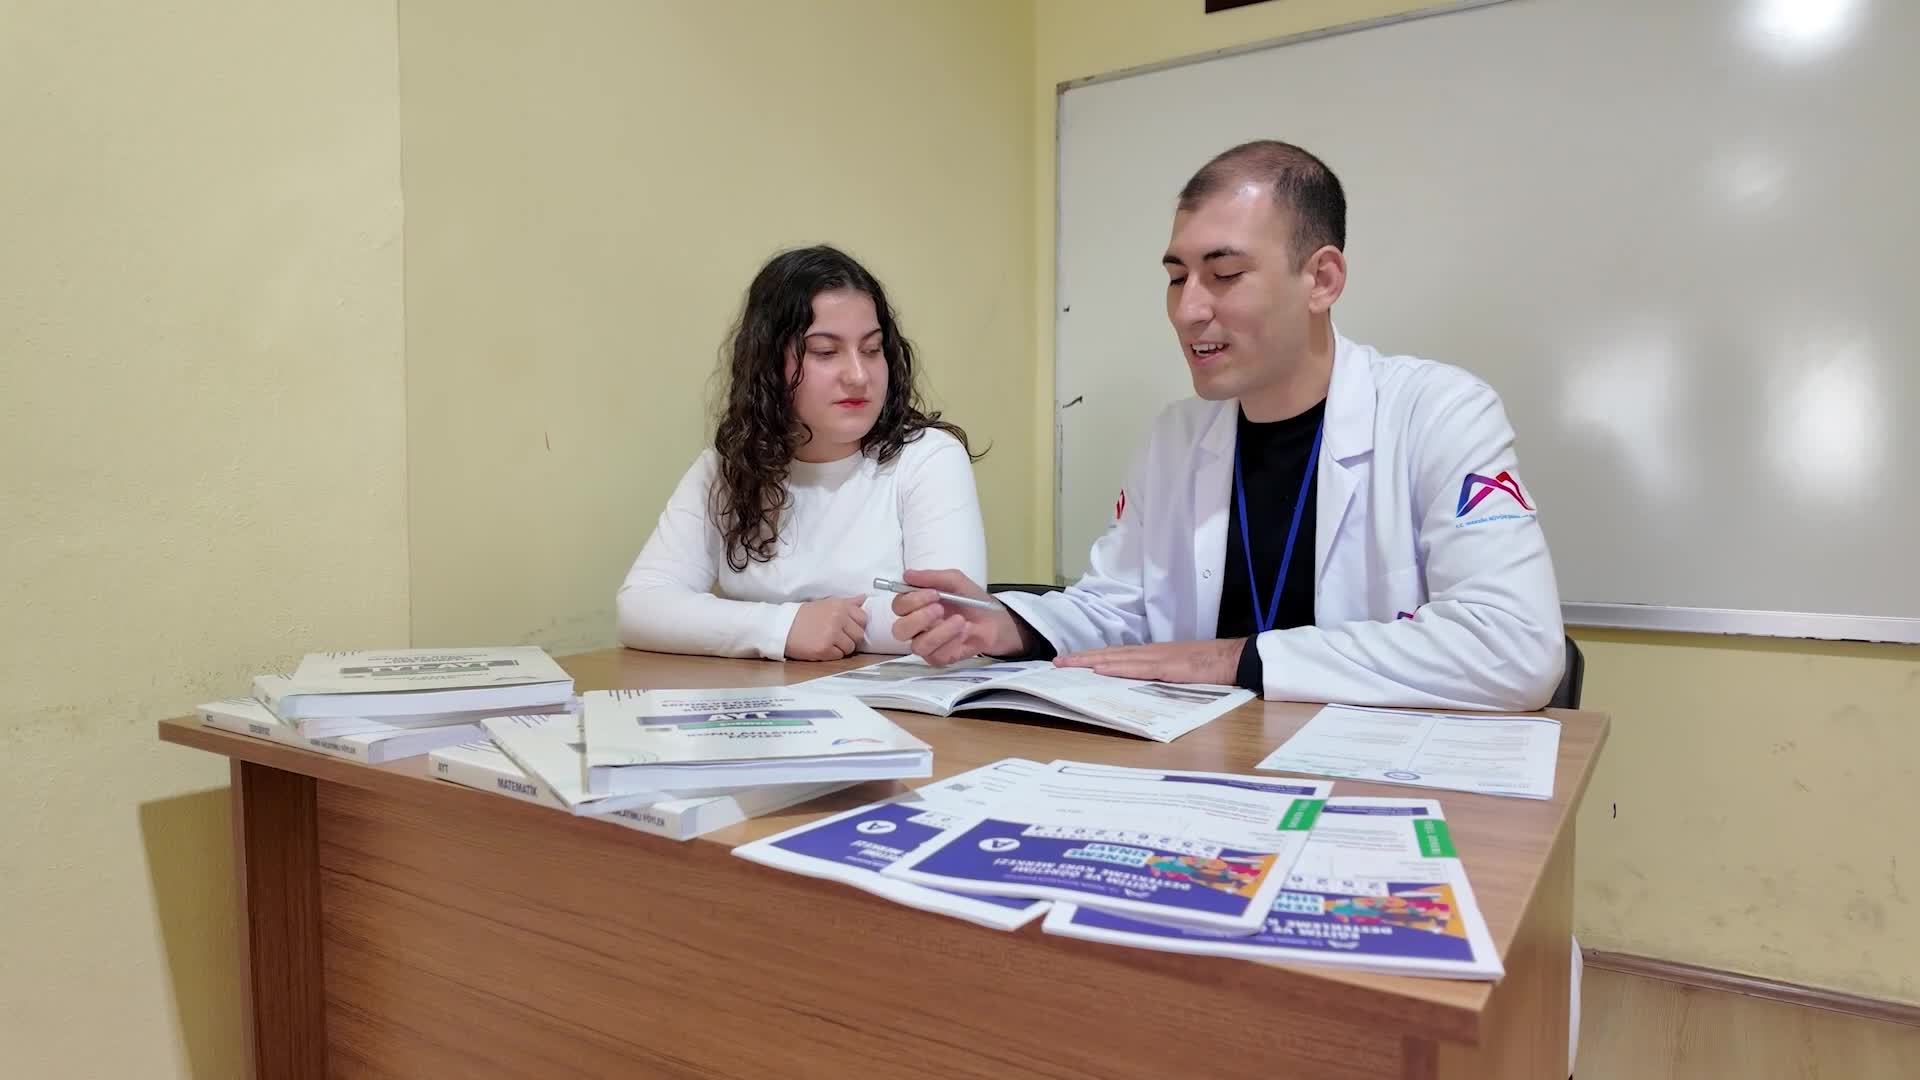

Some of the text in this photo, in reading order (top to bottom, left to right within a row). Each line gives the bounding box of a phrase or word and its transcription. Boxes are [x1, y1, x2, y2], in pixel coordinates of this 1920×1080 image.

[708, 711, 771, 721] AYT
[438, 762, 448, 775] AYT
[497, 776, 537, 797] MATEMATİK
[1070, 850, 1143, 865] DENEME
[1089, 845, 1148, 858] SINAVI
[1058, 863, 1097, 873] KURS
[1083, 873, 1102, 882] VE
[1101, 868, 1192, 891] DESTEKLEME
[1105, 875, 1158, 892] EĞİTİM
[1273, 926, 1361, 940] EĞİTİM VE
[1286, 920, 1393, 935] DESTEKLEME
